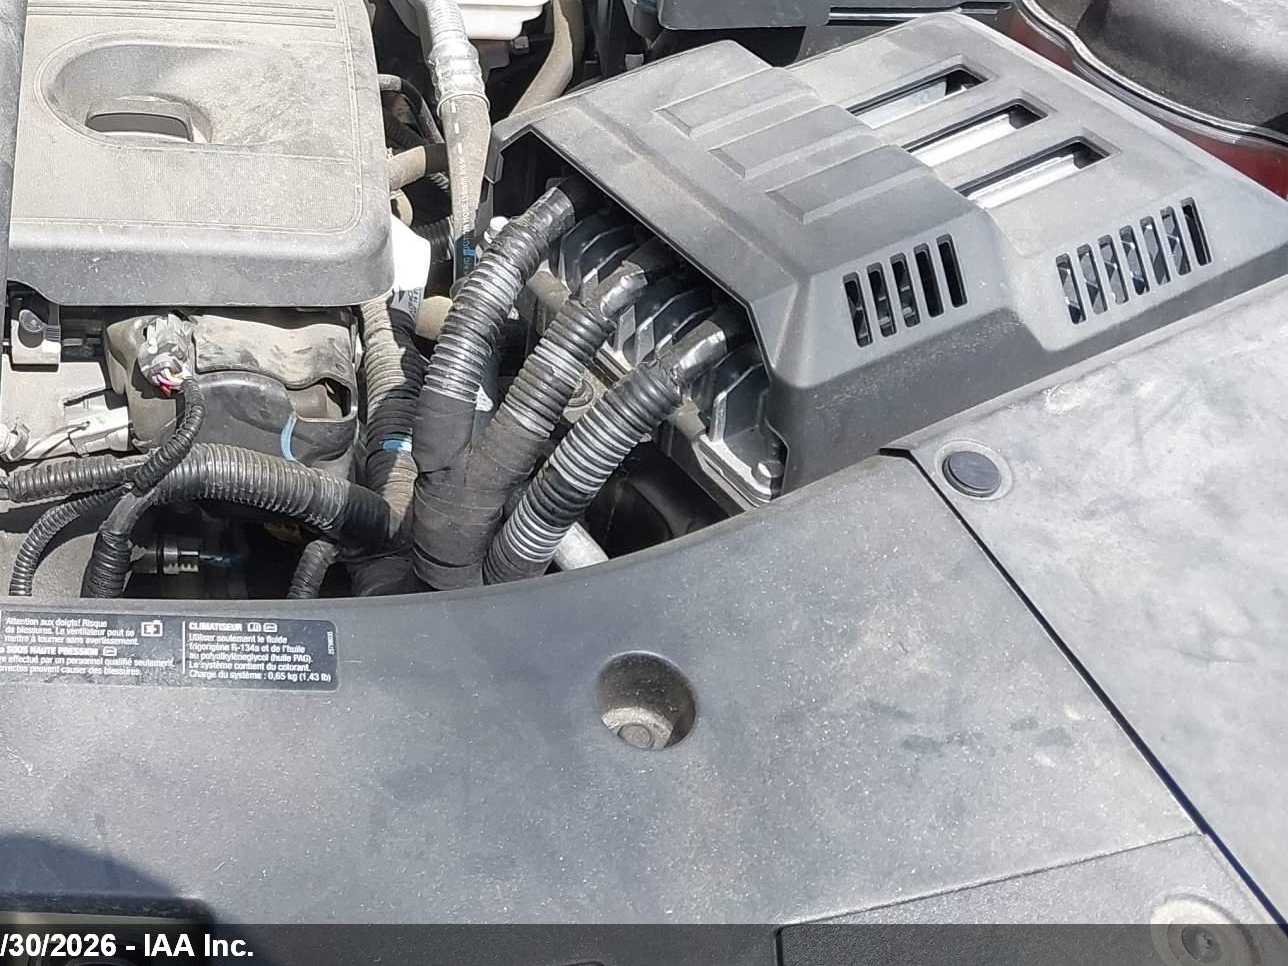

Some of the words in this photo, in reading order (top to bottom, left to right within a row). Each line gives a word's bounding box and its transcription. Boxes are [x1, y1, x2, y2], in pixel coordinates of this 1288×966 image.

[6, 617, 39, 626] Attention
[40, 619, 54, 627] aux
[55, 618, 81, 628] doigts!
[82, 619, 108, 628] Risque
[188, 622, 243, 632] CLIMATISEUR
[5, 626, 15, 634] de
[16, 626, 54, 635] blessures.
[55, 627, 65, 635] Le
[66, 628, 106, 636] ventilateur
[107, 629, 125, 637] peut
[4, 634, 30, 642] mettre
[31, 634, 37, 643] à
[37, 635, 65, 643] tourner
[66, 636, 84, 644] sans
[85, 637, 139, 646] avertissement.
[189, 633, 216, 642] Utiliser
[216, 634, 256, 643] seulement
[257, 635, 265, 643] le
[266, 635, 288, 644] fluide
[6, 645, 29, 654] SOUS
[29, 646, 57, 655] HAUTE
[58, 646, 99, 656] PRESSION
[231, 643, 260, 652] R-134a
[270, 645, 281, 653] de
[282, 645, 306, 653] l'huile
[8, 654, 39, 664] effectué
[40, 657, 54, 665] par
[54, 657, 65, 665] un
[66, 657, 104, 666] personnel
[104, 657, 133, 667] qualifié
[270, 653, 292, 662] (huile
[29, 665, 60, 675] peuvent
[60, 666, 87, 674] causer
[88, 666, 103, 674] des
[189, 660, 199, 669] Le
[200, 661, 233, 671] système
[233, 662, 265, 670] contient
[266, 662, 277, 671] du
[278, 663, 312, 672] colorant.
[189, 669, 217, 680] Charge
[218, 670, 229, 679] du
[229, 670, 262, 680] système
[267, 671, 286, 681] 0,65
[287, 672, 298, 683] kg
[320, 673, 332, 683] lb)
